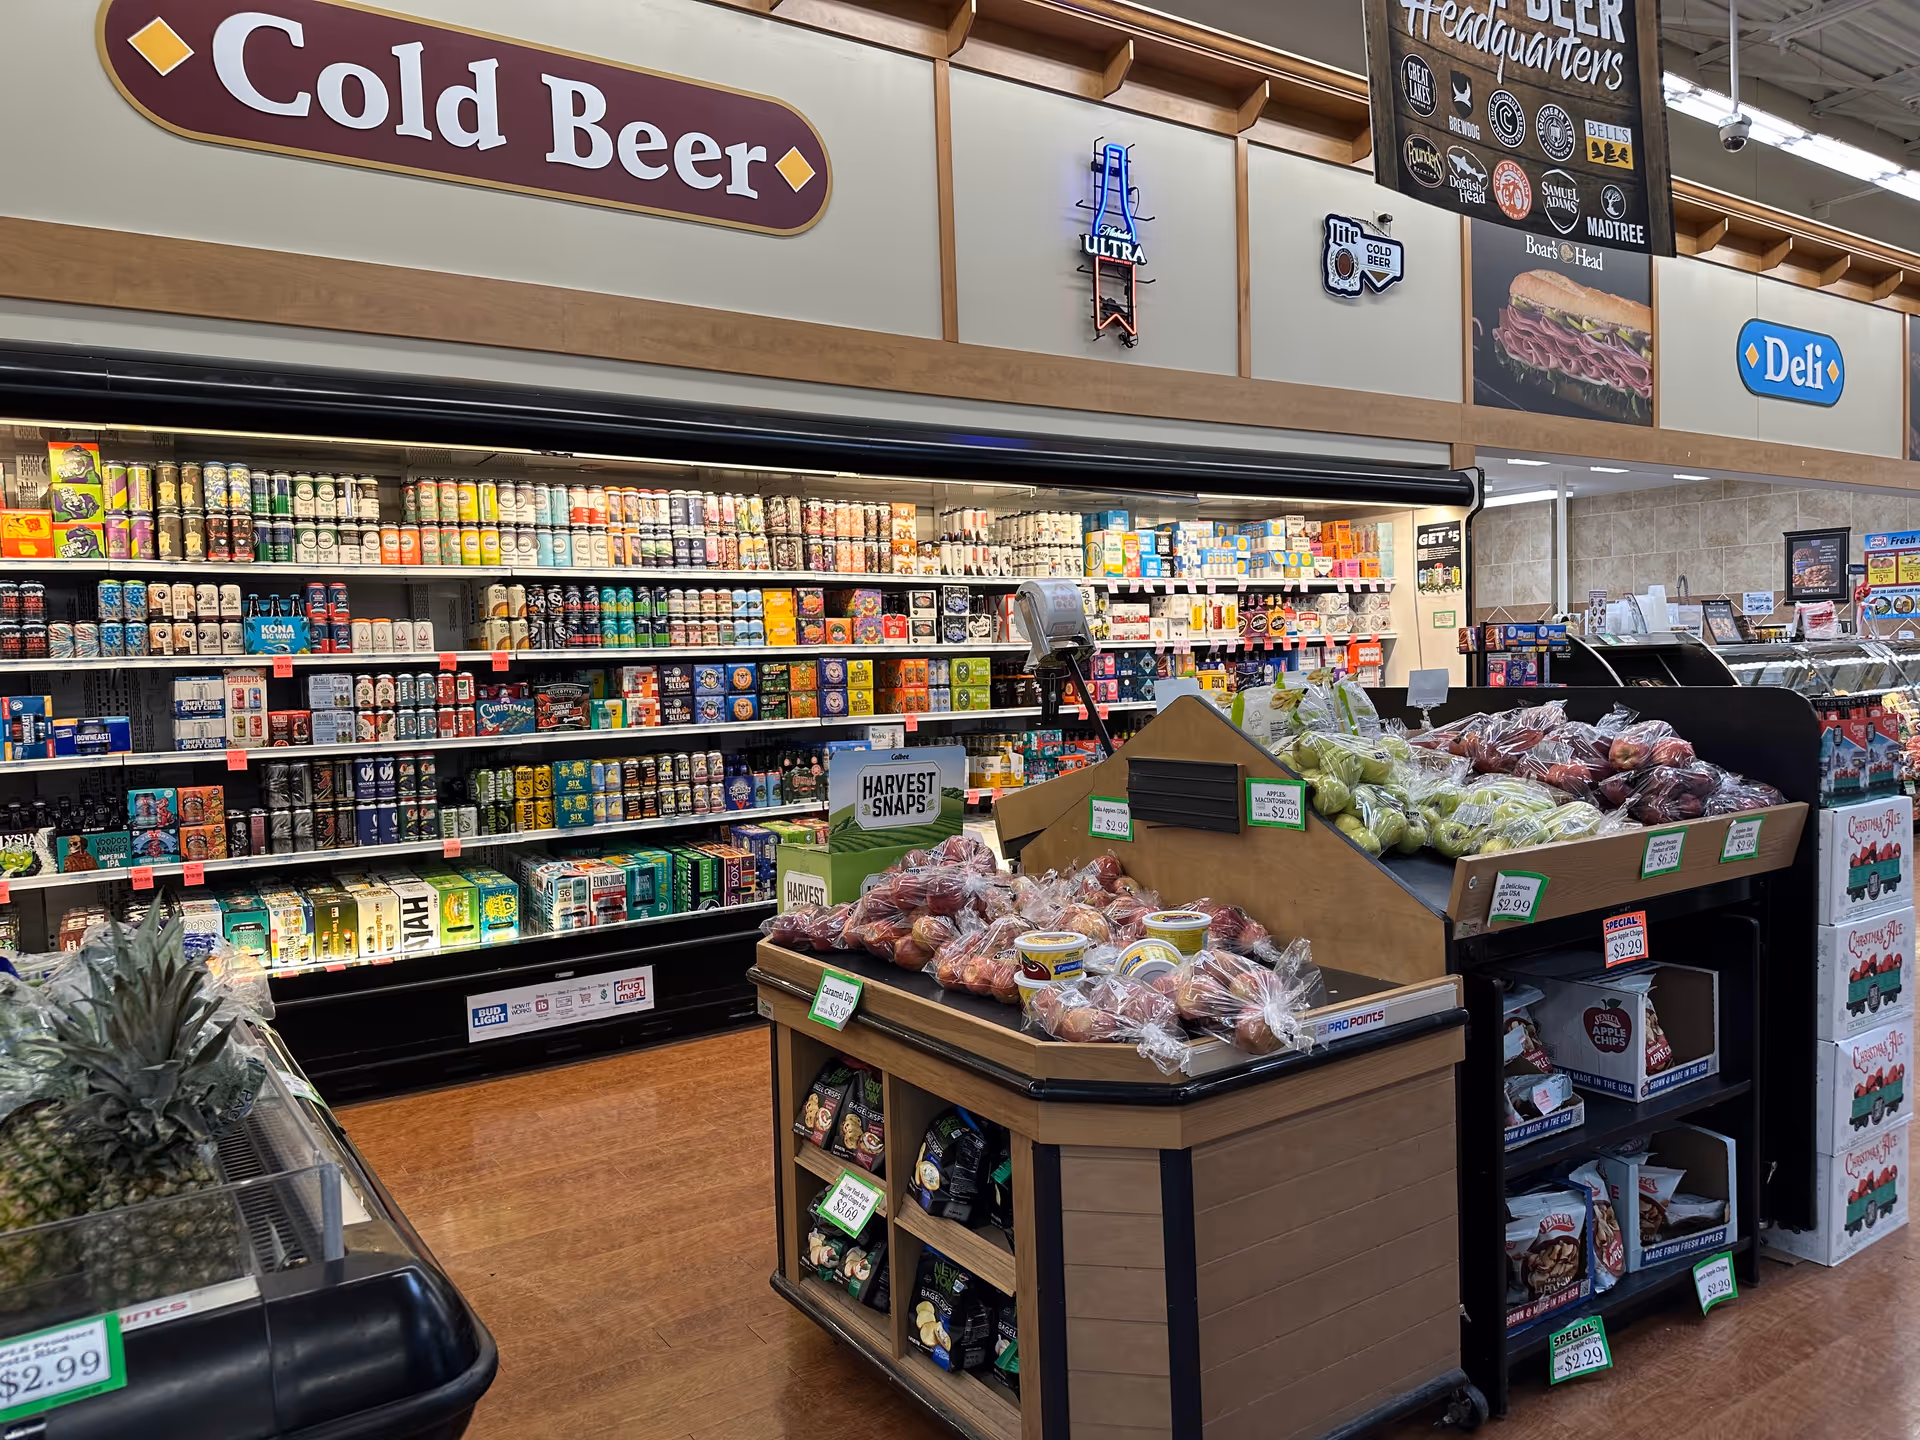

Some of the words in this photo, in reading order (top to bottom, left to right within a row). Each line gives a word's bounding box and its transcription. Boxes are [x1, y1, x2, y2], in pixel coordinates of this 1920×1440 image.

[1402, 0, 1624, 91] Headquarters
[1407, 61, 1429, 86] GREAT
[1409, 80, 1431, 105] LAKES
[212, 11, 506, 152] Cold
[541, 72, 767, 200] Beer
[1449, 115, 1480, 140] BREWDOG
[1538, 106, 1564, 136] SOUTHERN
[1564, 121, 1574, 143] TIER
[1588, 122, 1629, 143] BELL'S
[1407, 140, 1442, 180] Founders
[1449, 174, 1482, 193] Dogfish
[1504, 163, 1529, 195] BELGIUM
[1459, 188, 1486, 204] Head
[1541, 181, 1580, 203] SAMUEL
[1546, 195, 1577, 214] ADAMS
[1329, 223, 1358, 246] Lite
[1586, 216, 1645, 245] MADTREE
[1085, 234, 1147, 264] ULTRA
[1366, 242, 1392, 257] COLD
[1525, 234, 1558, 261] Boar's
[1574, 246, 1603, 272] Head
[1367, 254, 1391, 268] BEER
[1763, 335, 1824, 390] Deli
[1418, 532, 1445, 546] GET
[1447, 529, 1460, 543] $5
[1890, 535, 1916, 546] Fresh
[261, 624, 294, 634] KONA
[227, 675, 258, 684] CIDERBOYS
[664, 676, 681, 684] PIMP
[1212, 677, 1225, 688] GOLD
[480, 703, 532, 719] CHRISTMAS
[77, 733, 109, 742] DOWNEAST
[891, 753, 909, 761] Calbee
[863, 772, 936, 800] HARVEST
[872, 794, 926, 817] SNAPS
[1103, 806, 1115, 816] Apples
[1271, 806, 1300, 821] $2.99
[443, 811, 454, 839] RAJAH
[523, 803, 533, 831] RAJAH
[1106, 819, 1129, 834] $2.99
[1848, 815, 1883, 845] CHRISTMAS
[1882, 807, 1901, 840] ALE
[95, 836, 128, 846] VOODOO
[96, 844, 128, 854] RANGER
[1736, 839, 1755, 853] $2.99
[99, 853, 127, 861] IMPERIAL
[107, 860, 120, 868] IPA
[1656, 851, 1679, 867] $6.59
[593, 876, 609, 887] ELVIS
[609, 874, 625, 886] JUICE
[732, 864, 740, 888] BOX
[787, 881, 825, 905] HARVEST
[1505, 883, 1530, 891] Delicious
[1496, 898, 1531, 913] $2.99
[1605, 915, 1642, 932] SPECIAL!
[1617, 932, 1629, 941] Apple
[1629, 928, 1643, 938] Chips
[1849, 928, 1884, 958] CHRISTMAS
[1882, 919, 1903, 950] ALE
[1613, 938, 1642, 959] $2.29
[617, 982, 640, 993] drug
[619, 989, 644, 1001] mart
[822, 984, 844, 1000] Caramel
[844, 992, 854, 1006] Dip
[478, 1007, 502, 1018] BUD
[511, 1007, 532, 1016] WORKS
[512, 1003, 525, 1011] HOW
[474, 1013, 506, 1026] LIGHT
[1594, 1013, 1621, 1027] SENECA
[1592, 1026, 1626, 1038] APPLE
[1594, 1035, 1626, 1047] CHIPS
[1650, 1051, 1666, 1066] APPLE
[1852, 1039, 1885, 1074] CHRISTMAS
[1884, 1029, 1904, 1064] ALE
[1573, 1072, 1592, 1084] MADE
[1593, 1077, 1601, 1086] IN
[1604, 1079, 1616, 1090] THE
[1618, 1083, 1633, 1094] USA
[1650, 1078, 1665, 1090] GROWN
[1671, 1071, 1684, 1083] MADE
[1685, 1069, 1690, 1077] IN
[1690, 1067, 1698, 1076] THE
[1699, 1063, 1707, 1073] USA
[824, 1088, 842, 1100] CRISPS
[849, 1101, 867, 1117] BAGEL
[1526, 1122, 1541, 1134] MADE
[1542, 1120, 1549, 1128] IN
[1549, 1117, 1559, 1127] THE
[1560, 1113, 1571, 1124] USA
[1845, 1151, 1881, 1183] CHRISTMAS
[1880, 1132, 1899, 1164] ALE
[833, 1199, 858, 1222] $3.69
[1540, 1213, 1575, 1234] SENECA
[1645, 1247, 1662, 1261] MADE
[1663, 1244, 1680, 1257] FROM
[1680, 1239, 1699, 1254] FRESH
[1699, 1231, 1724, 1247] APPLES
[1716, 1265, 1728, 1275] Chips
[921, 1289, 940, 1304] BAGEL
[1708, 1277, 1731, 1298] $2.29
[1506, 1312, 1524, 1327] GROWN
[1532, 1301, 1550, 1314] MADE
[1550, 1297, 1557, 1307] IN
[1557, 1293, 1567, 1304] THE
[1568, 1288, 1579, 1300] USA
[32, 1329, 95, 1350] Product
[1553, 1320, 1598, 1347] SPECIAL!
[34, 1345, 68, 1360] Rica
[1553, 1346, 1570, 1359] Seneca
[1570, 1342, 1585, 1354] Apple
[1584, 1335, 1602, 1350] Chips
[1565, 1346, 1604, 1376] $2.29
[0, 1350, 100, 1401] $2.99
